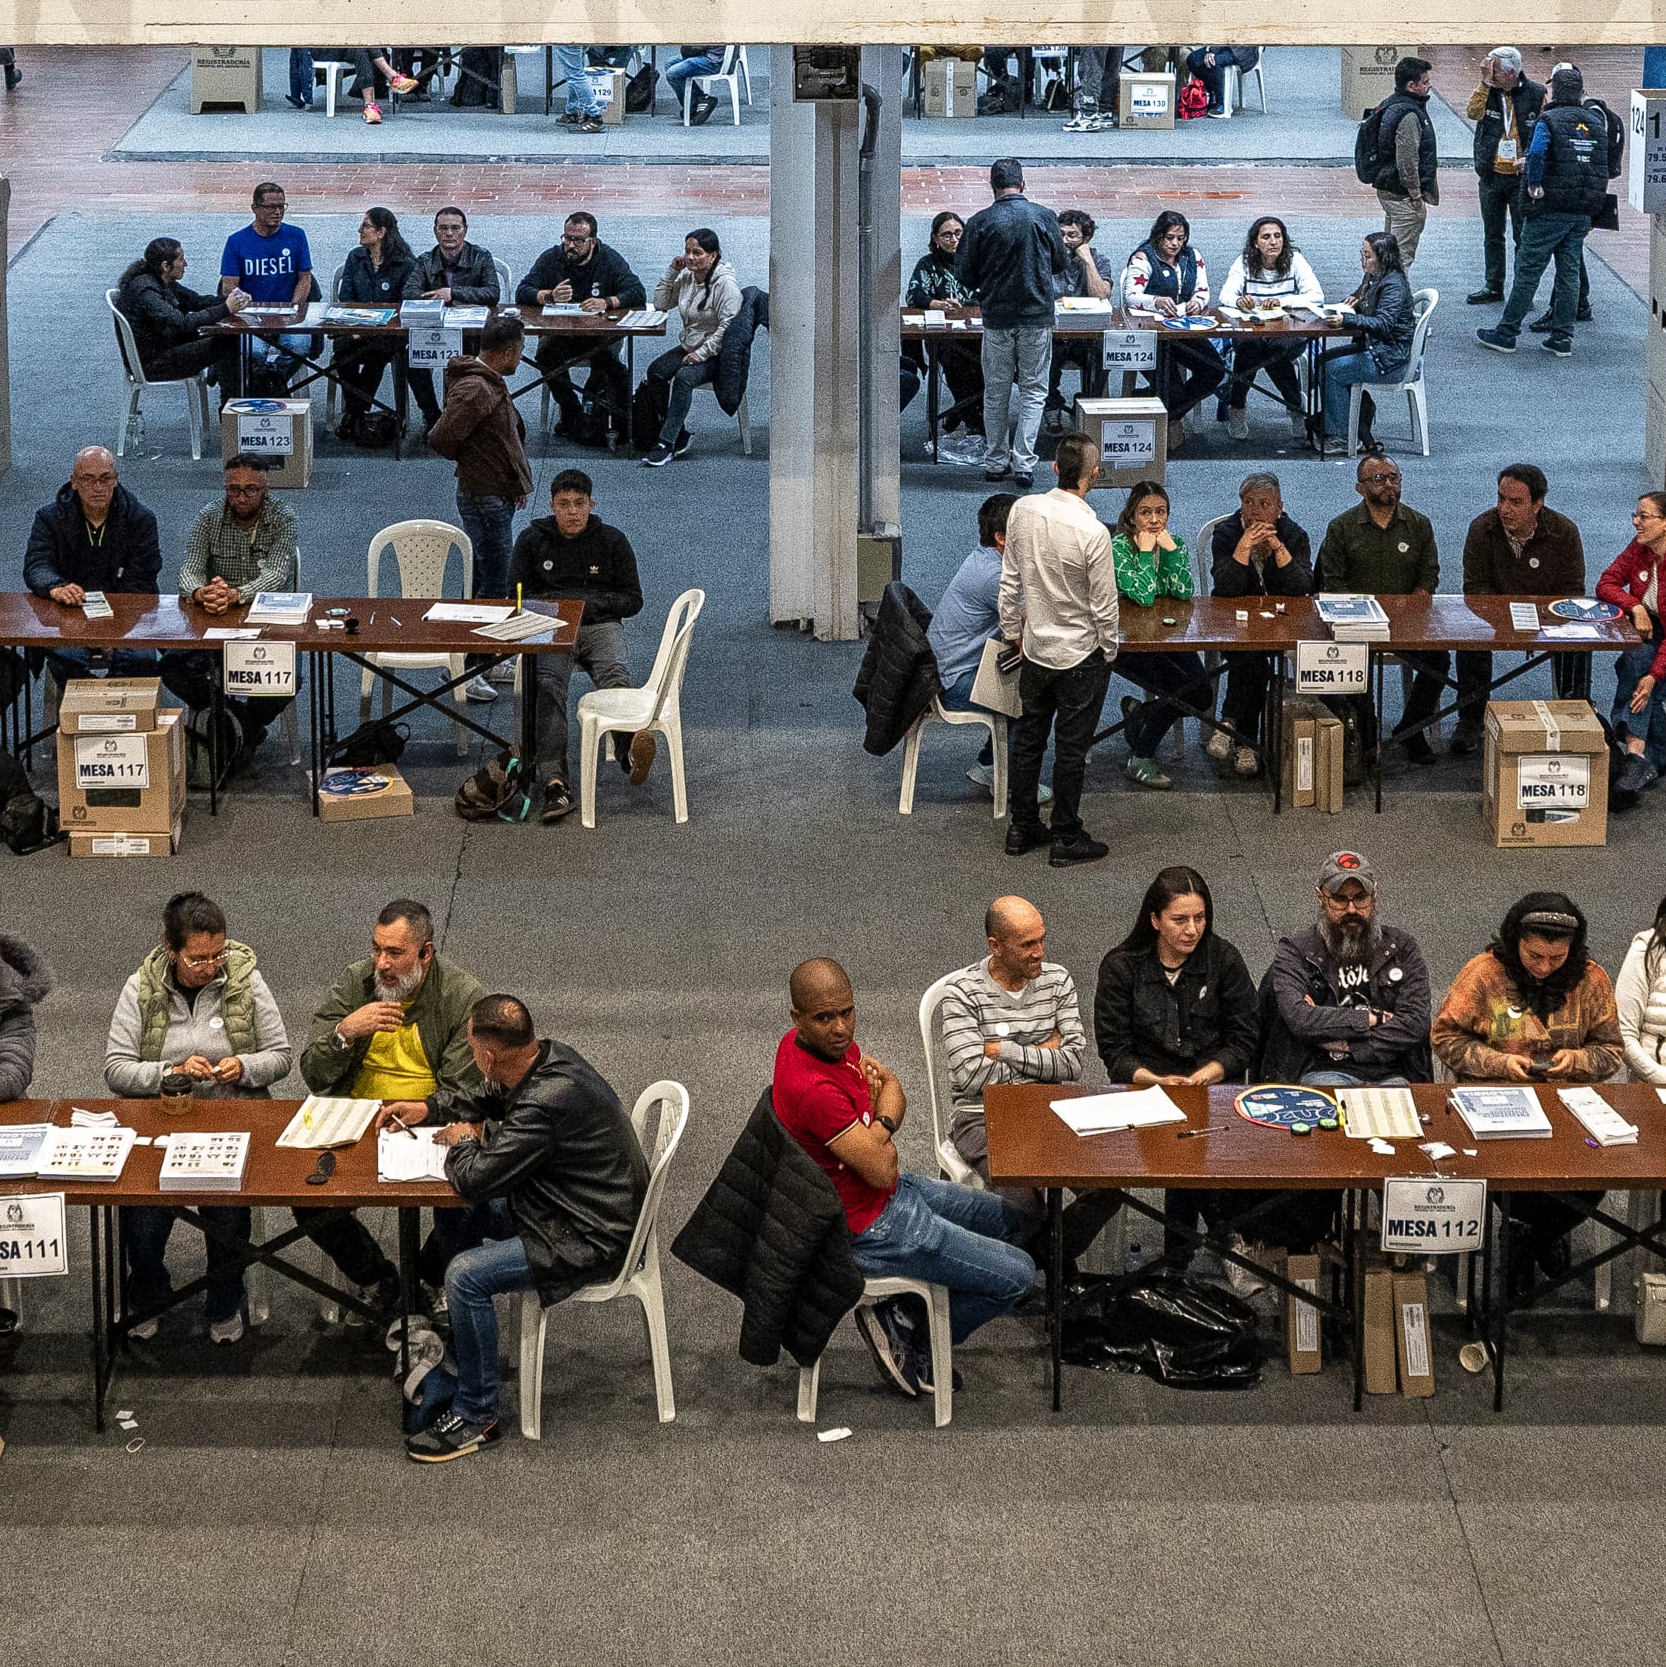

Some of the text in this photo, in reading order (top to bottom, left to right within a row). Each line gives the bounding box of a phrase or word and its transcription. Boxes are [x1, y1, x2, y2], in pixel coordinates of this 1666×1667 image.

[1152, 99, 1166, 107] 130
[1631, 104, 1645, 137] 124
[245, 256, 294, 276] DIESEL
[412, 349, 438, 360] MESA
[1107, 352, 1154, 362] MESA 124
[241, 436, 290, 447] MESA 123
[1104, 442, 1152, 453] MESA 124
[228, 670, 292, 685] MESA 117
[1300, 669, 1365, 683] MESA 118
[79, 764, 144, 777] MESA 117
[1522, 784, 1586, 798] MESA 118
[1388, 1219, 1479, 1238] MESA 112
[24, 1238, 60, 1260] 111
